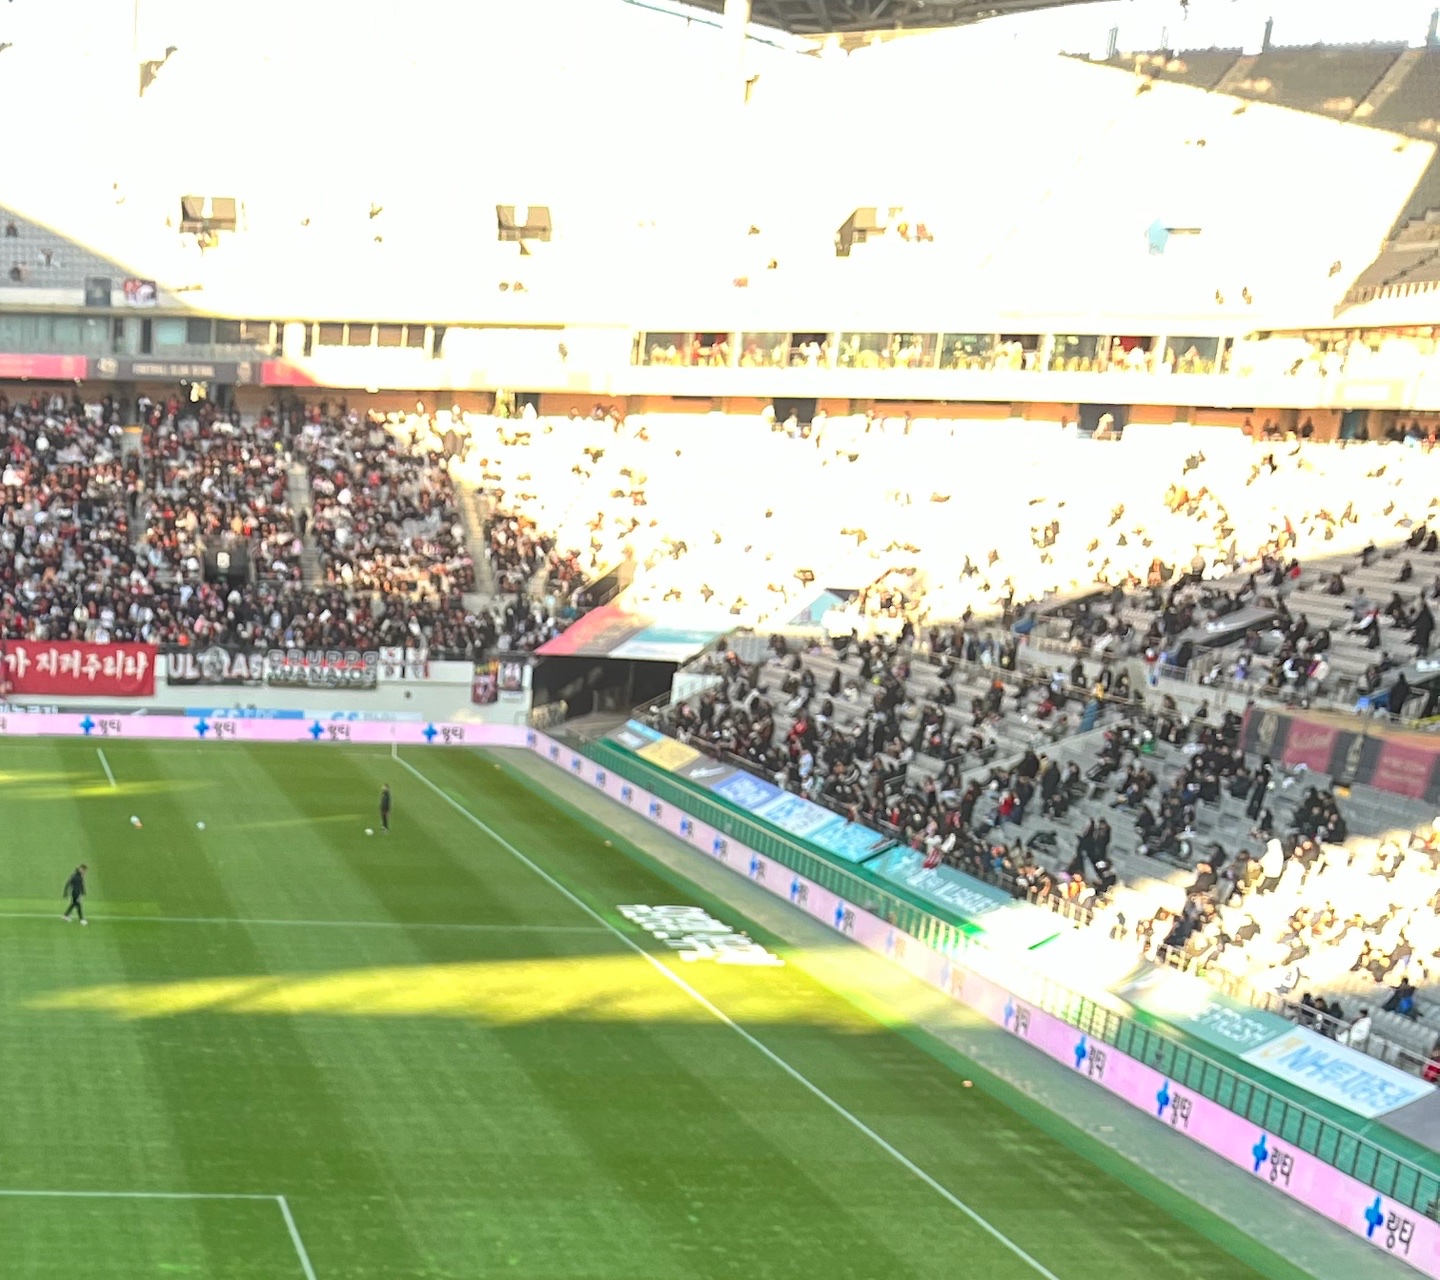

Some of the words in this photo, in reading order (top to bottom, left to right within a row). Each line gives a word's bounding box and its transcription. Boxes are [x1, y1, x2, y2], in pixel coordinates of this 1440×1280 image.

[36, 647, 148, 682] 지켜주리라
[1269, 1147, 1295, 1187] 링티
[1386, 1211, 1417, 1255] 링티
